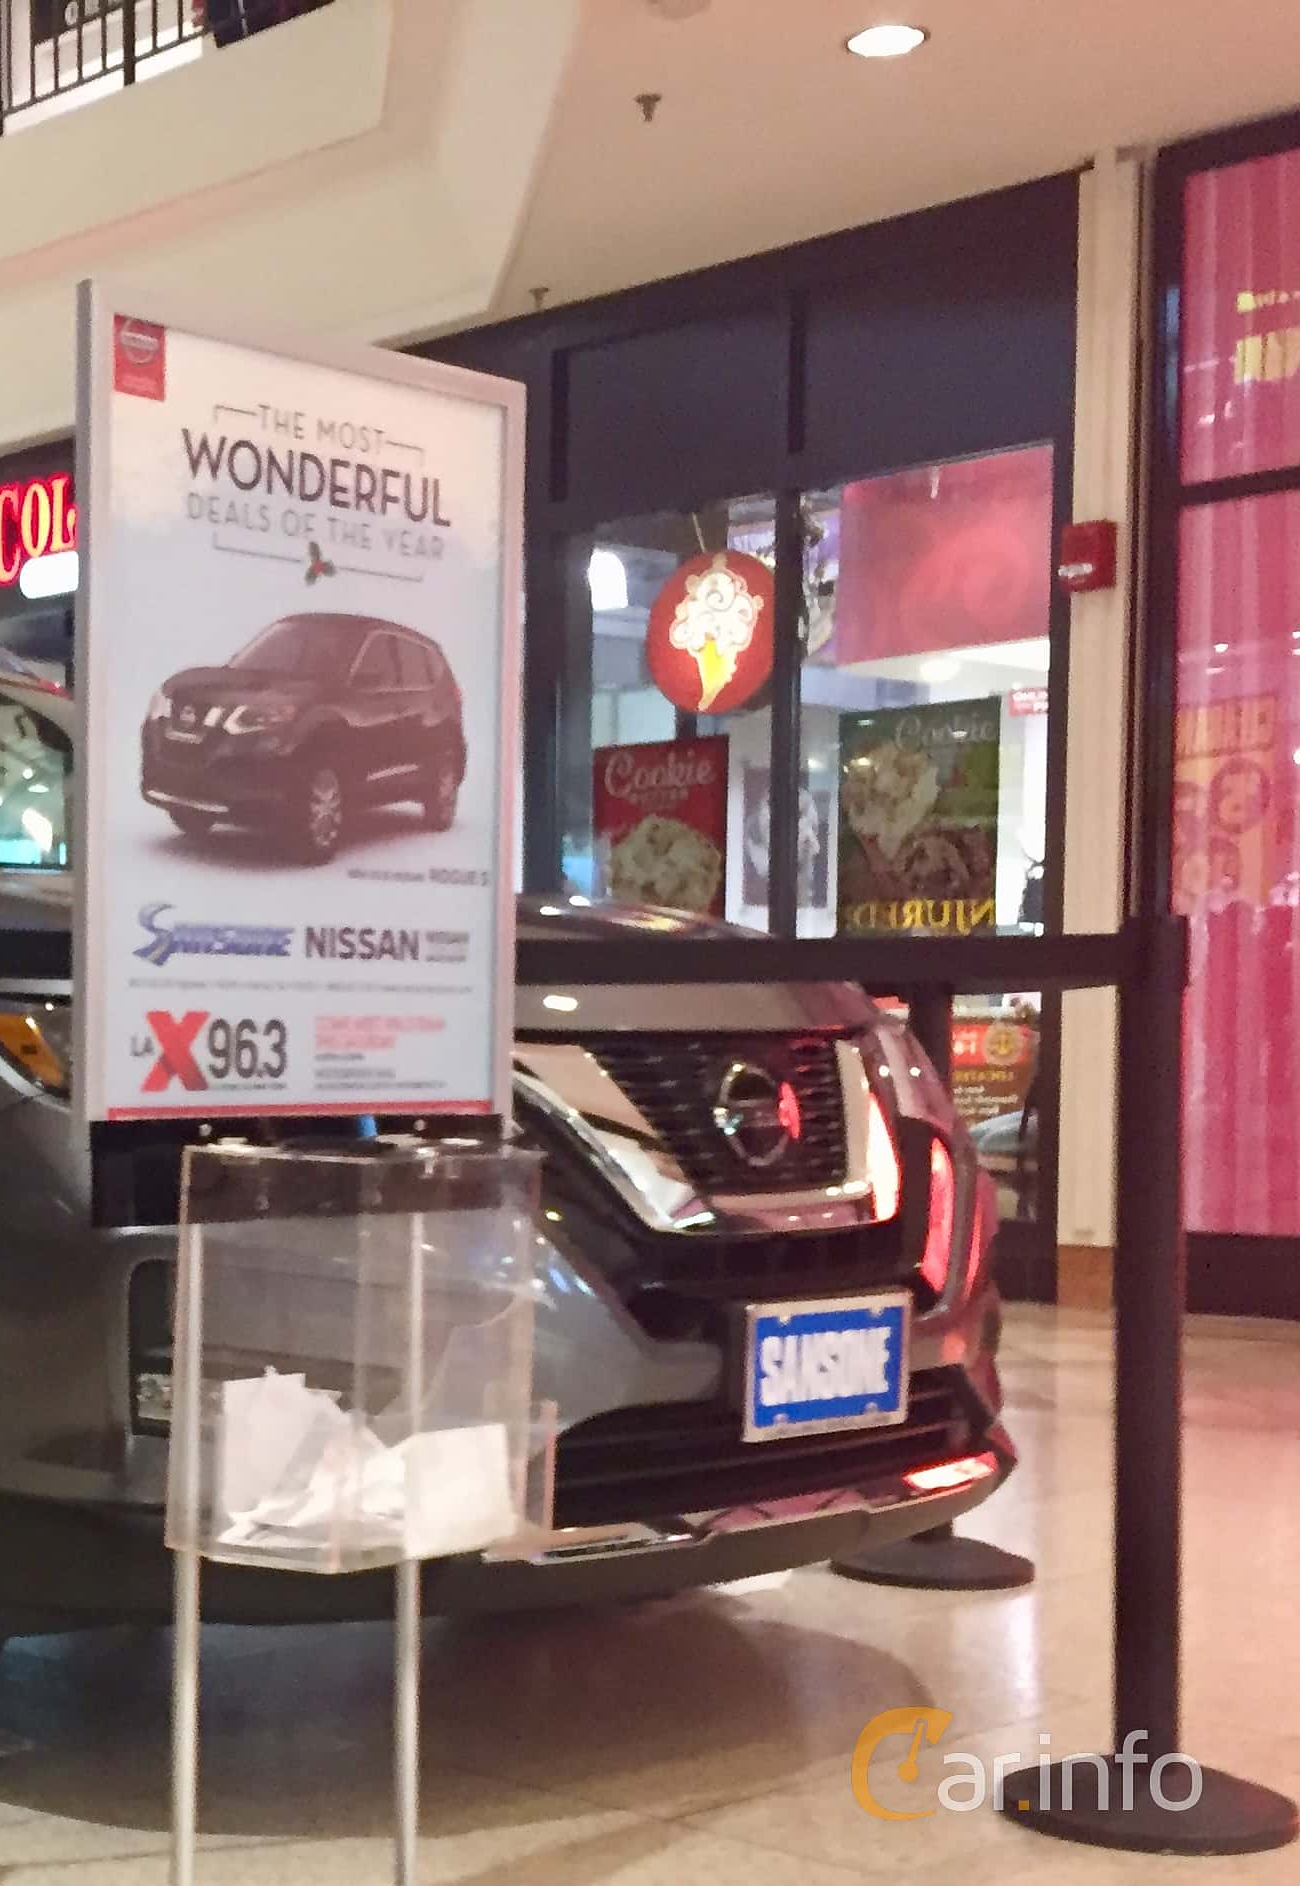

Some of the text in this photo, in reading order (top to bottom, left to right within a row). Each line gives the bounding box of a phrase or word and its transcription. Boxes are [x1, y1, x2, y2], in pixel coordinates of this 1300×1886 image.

[258, 403, 386, 455] THE MOST
[181, 427, 452, 528] WONDERFUL
[186, 492, 446, 561] DEALS OF THE YEAR
[604, 749, 719, 798] Cookie
[304, 925, 420, 962] NISSAN
